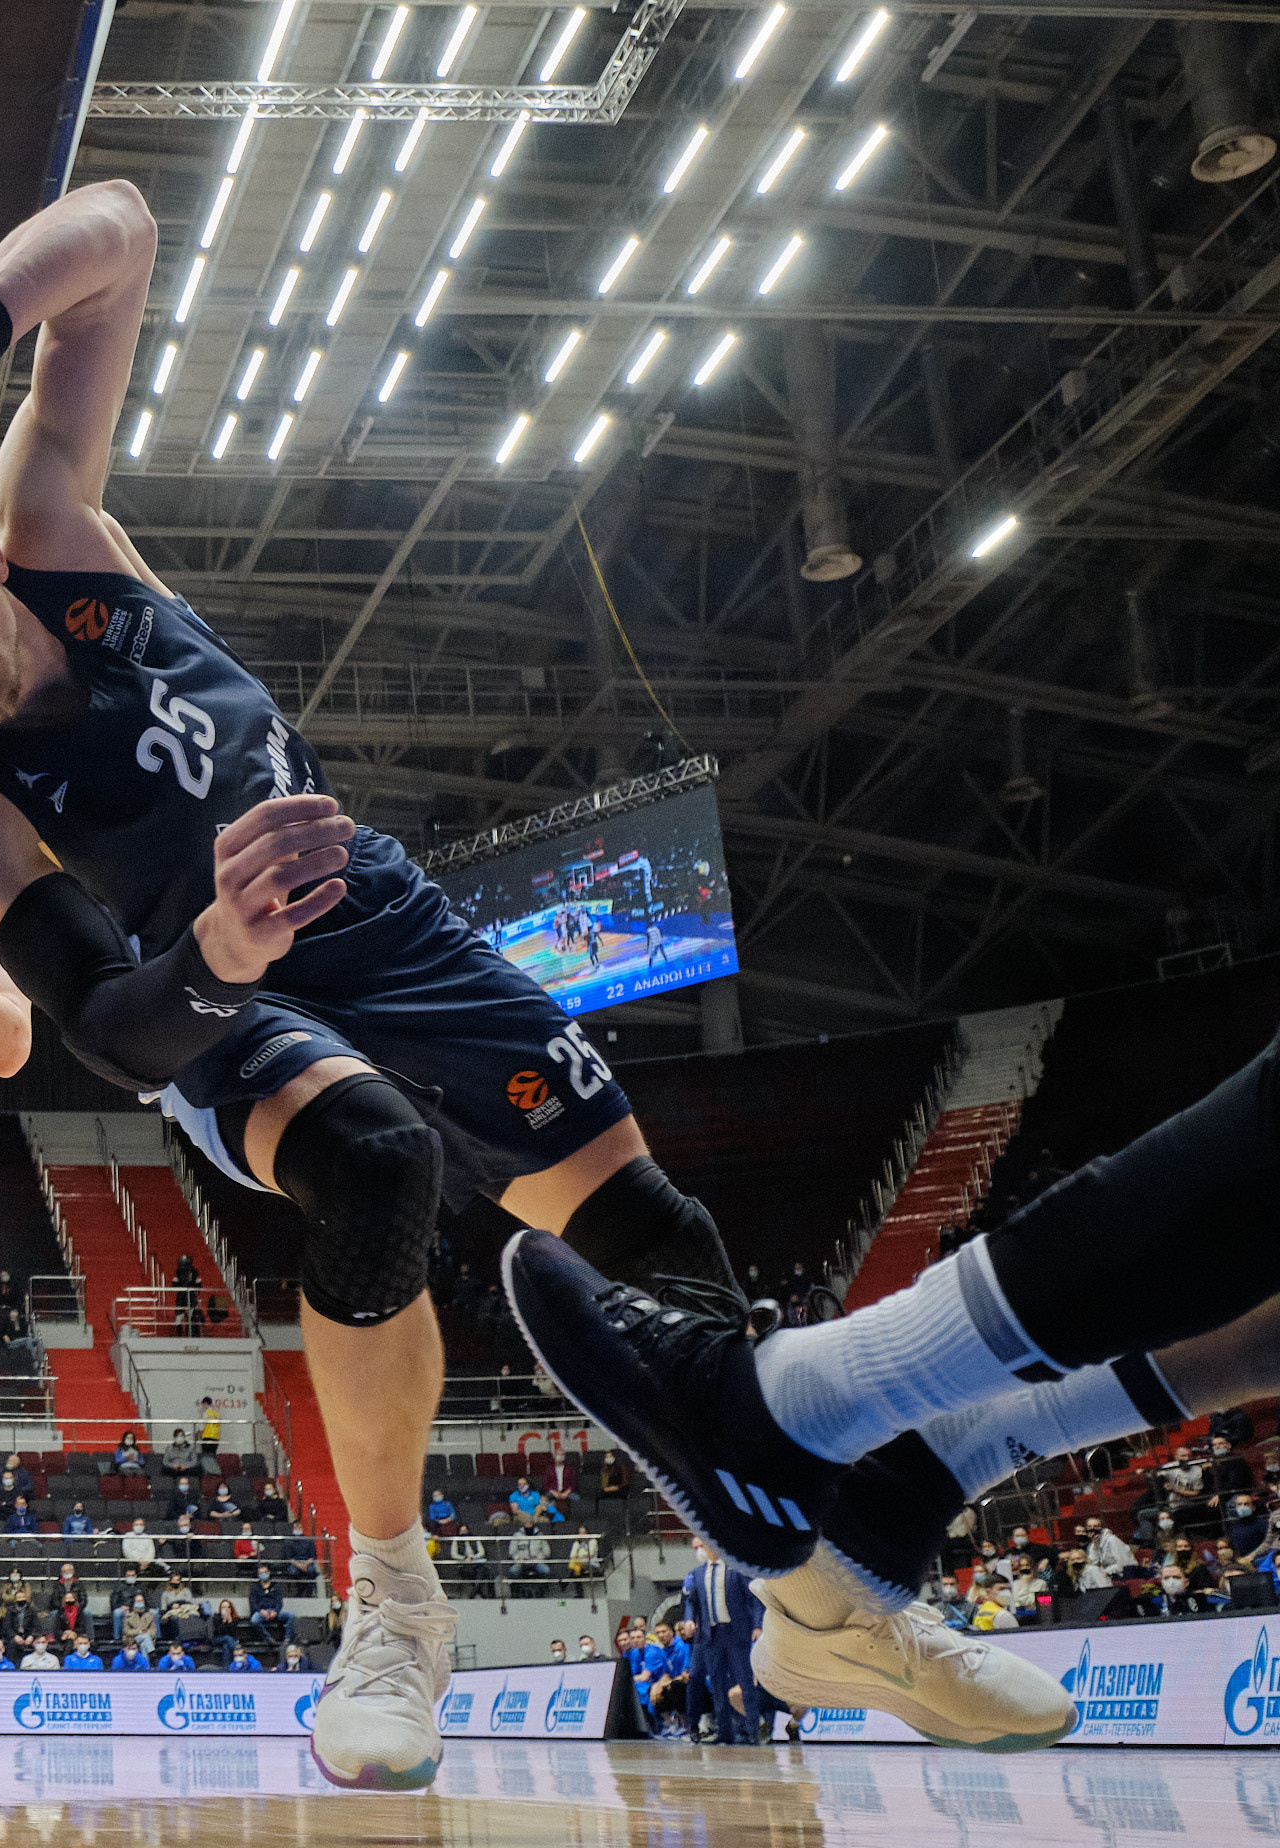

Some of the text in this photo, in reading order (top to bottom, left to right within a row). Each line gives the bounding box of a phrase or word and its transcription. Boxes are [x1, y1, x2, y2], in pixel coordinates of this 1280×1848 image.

[135, 677, 216, 800] 25
[606, 982, 625, 1000] 22
[546, 1020, 613, 1100] 25
[1088, 1662, 1164, 1697] ГАЗПРОМ
[45, 1692, 256, 1711] ГАЗПРОМ ГАЗПРОМ
[1087, 1701, 1158, 1718] ТРАНСГАЗ
